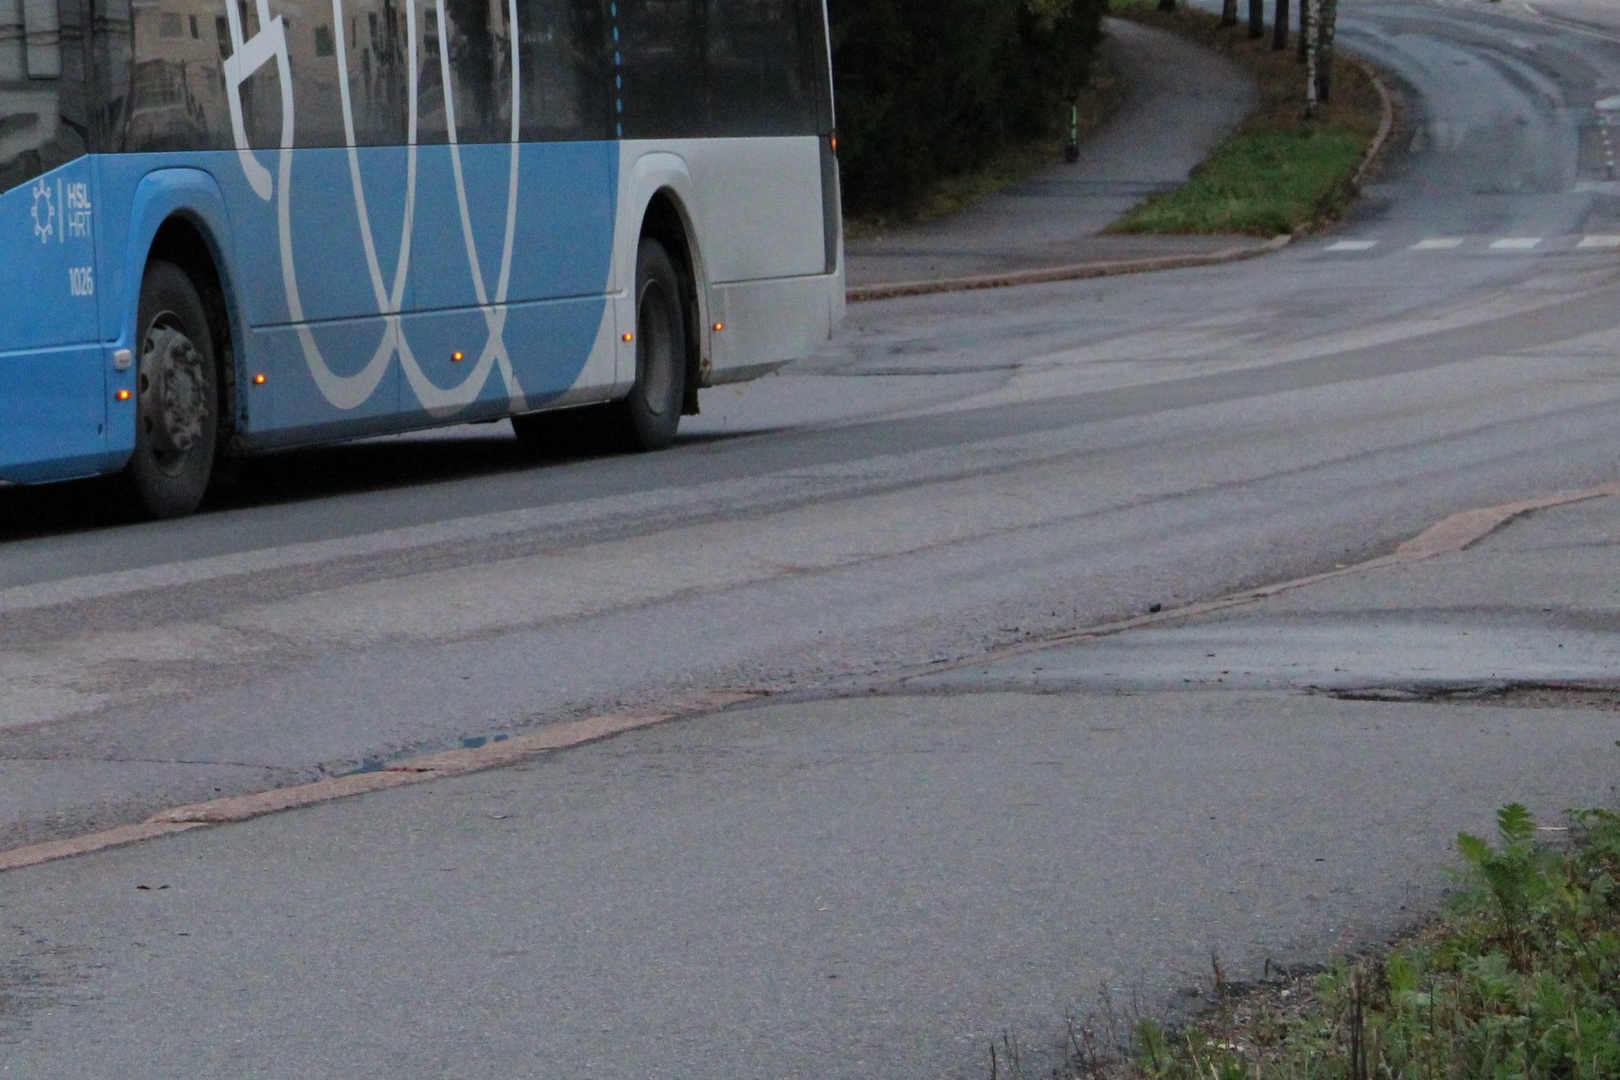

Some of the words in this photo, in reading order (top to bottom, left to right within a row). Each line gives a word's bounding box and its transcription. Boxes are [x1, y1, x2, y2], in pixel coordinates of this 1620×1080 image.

[67, 183, 92, 209] HSL
[68, 211, 92, 237] HRT
[68, 267, 94, 296] 1026
